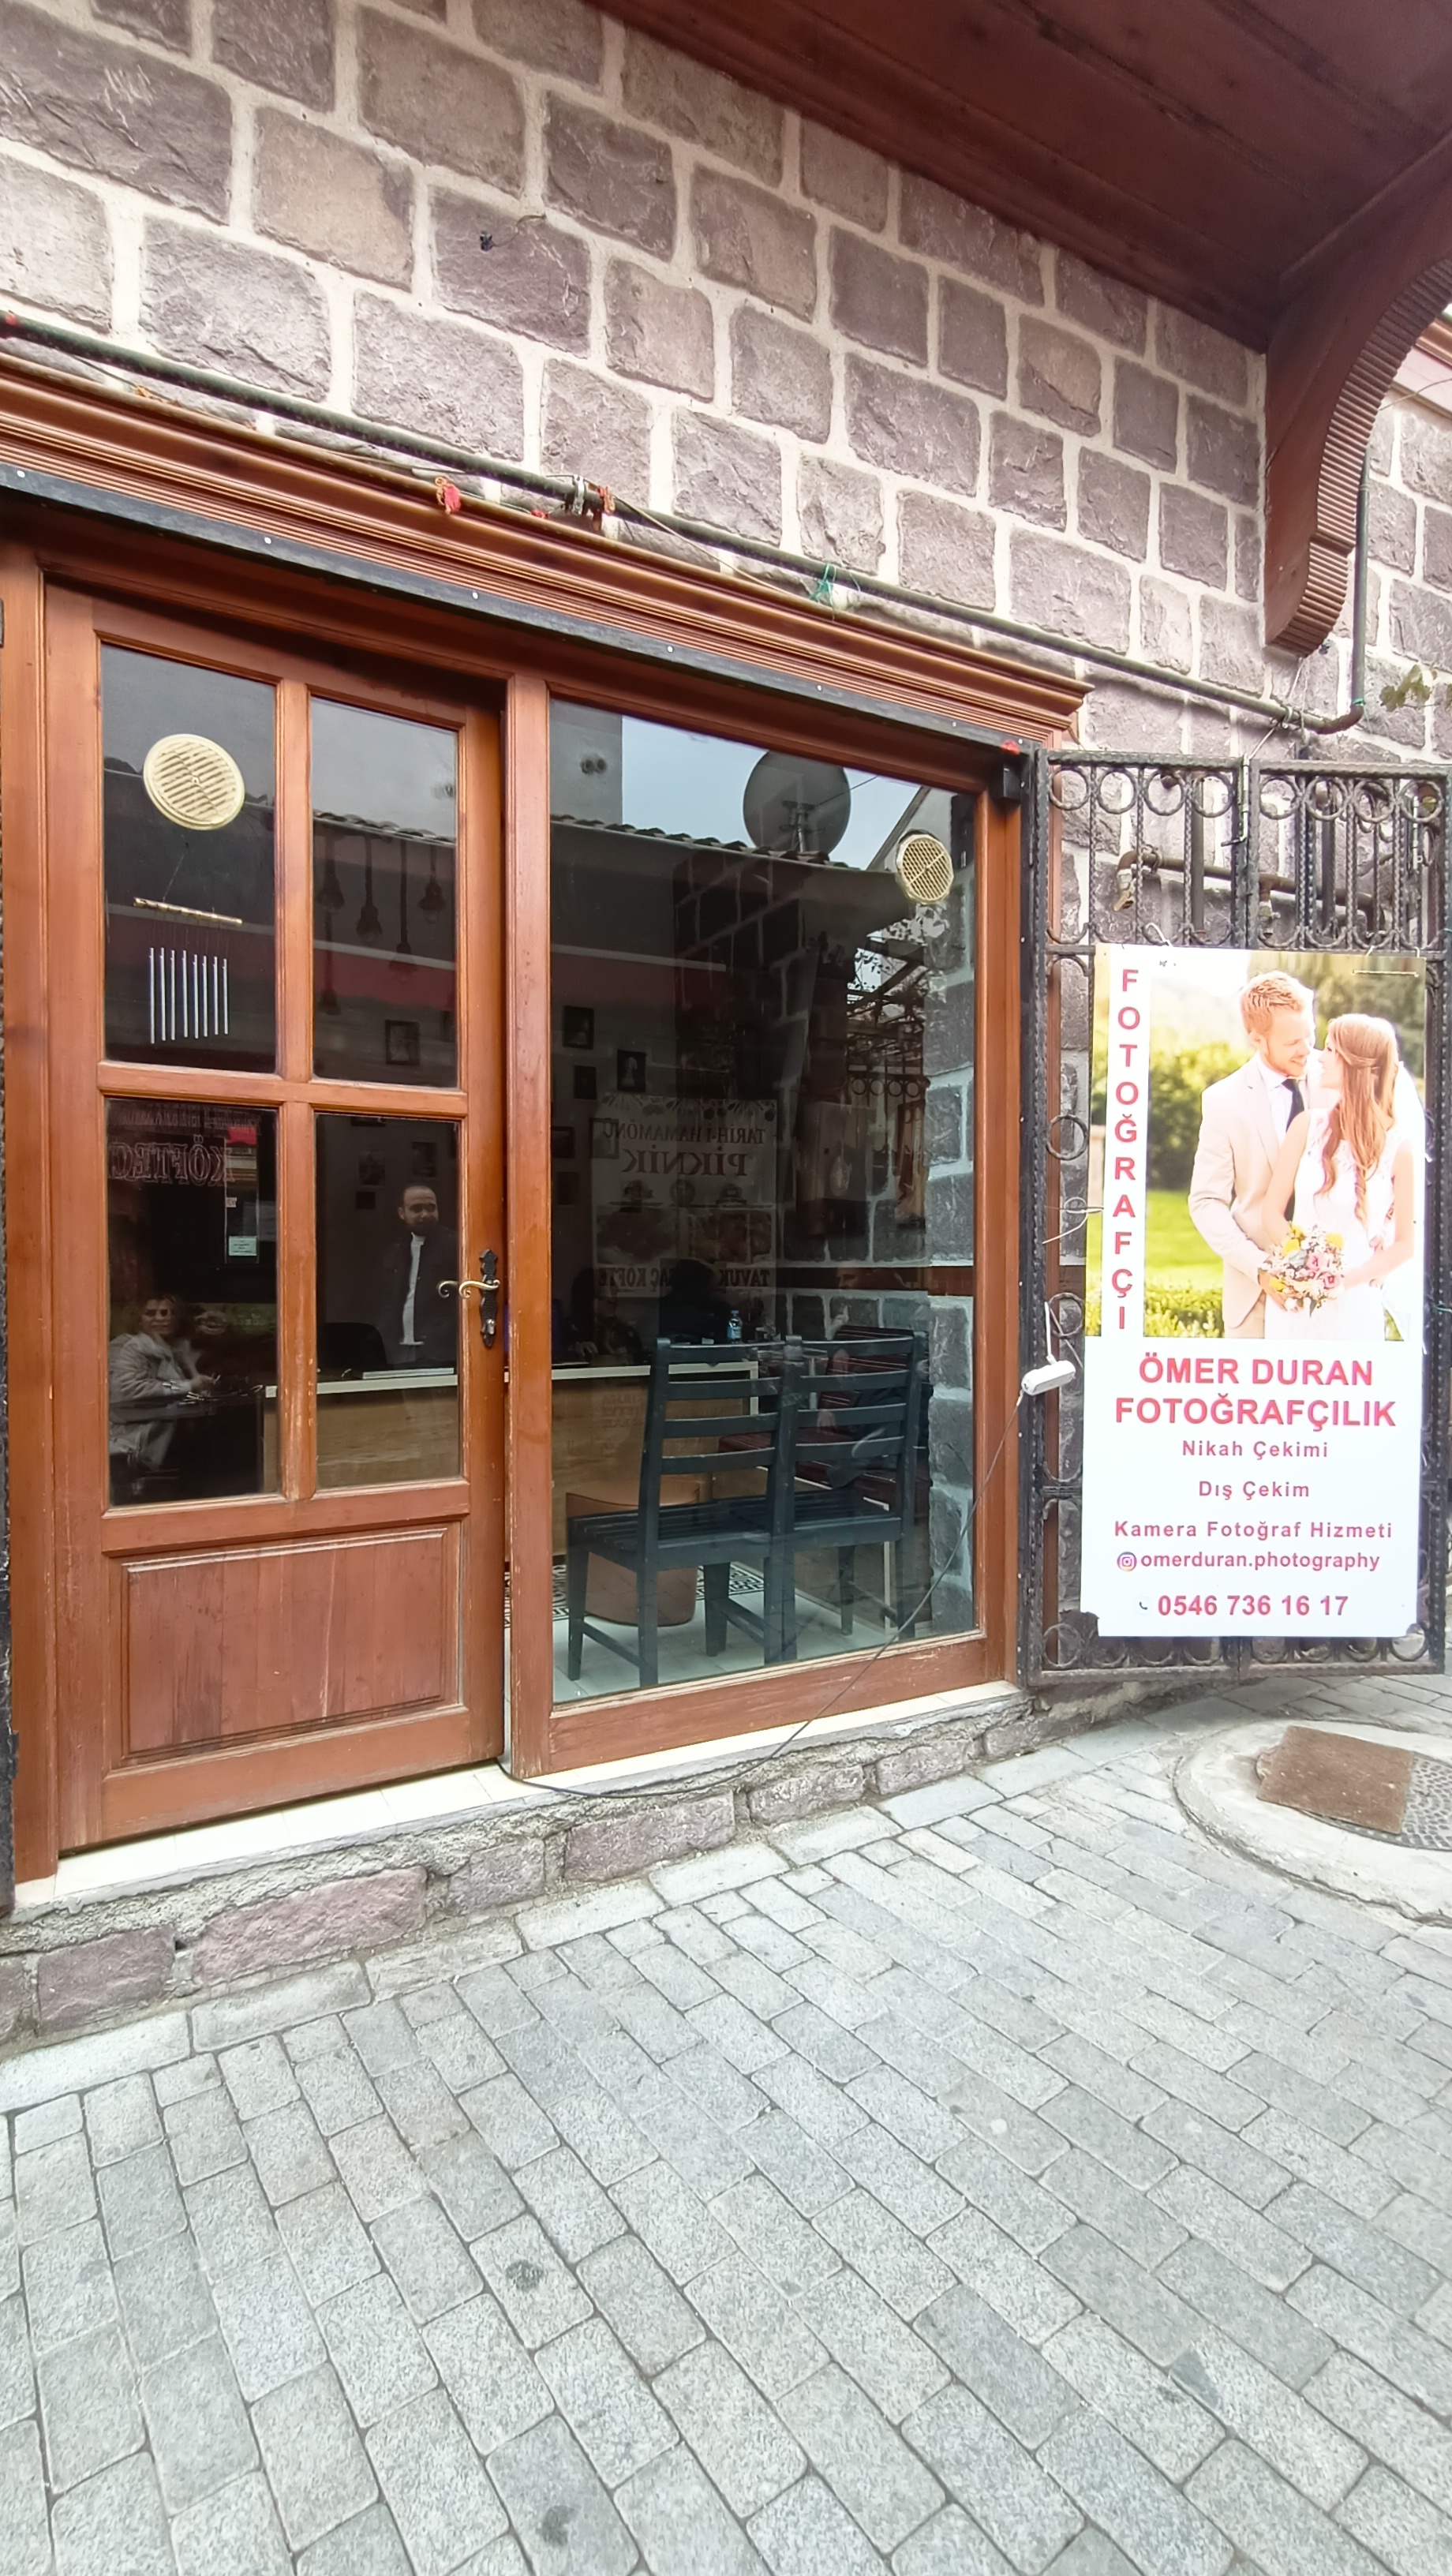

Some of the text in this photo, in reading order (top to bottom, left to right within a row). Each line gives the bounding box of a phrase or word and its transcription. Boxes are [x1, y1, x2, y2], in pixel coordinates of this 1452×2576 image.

[1110, 969, 1140, 1329] FOTOĞRAFÇI
[1140, 1352, 1372, 1387] ÖMER DURAN
[1115, 1393, 1395, 1432] FOTOĞRAFÇILIK
[1182, 1441, 1328, 1459] Nikah Çekimi
[1199, 1481, 1310, 1501] Dış Çekim
[1114, 1522, 1392, 1541] Kamera Fotoğraf Hizmeti
[1141, 1552, 1379, 1571] omerduran.photography
[1158, 1596, 1348, 1616] 0546 736 16 17
